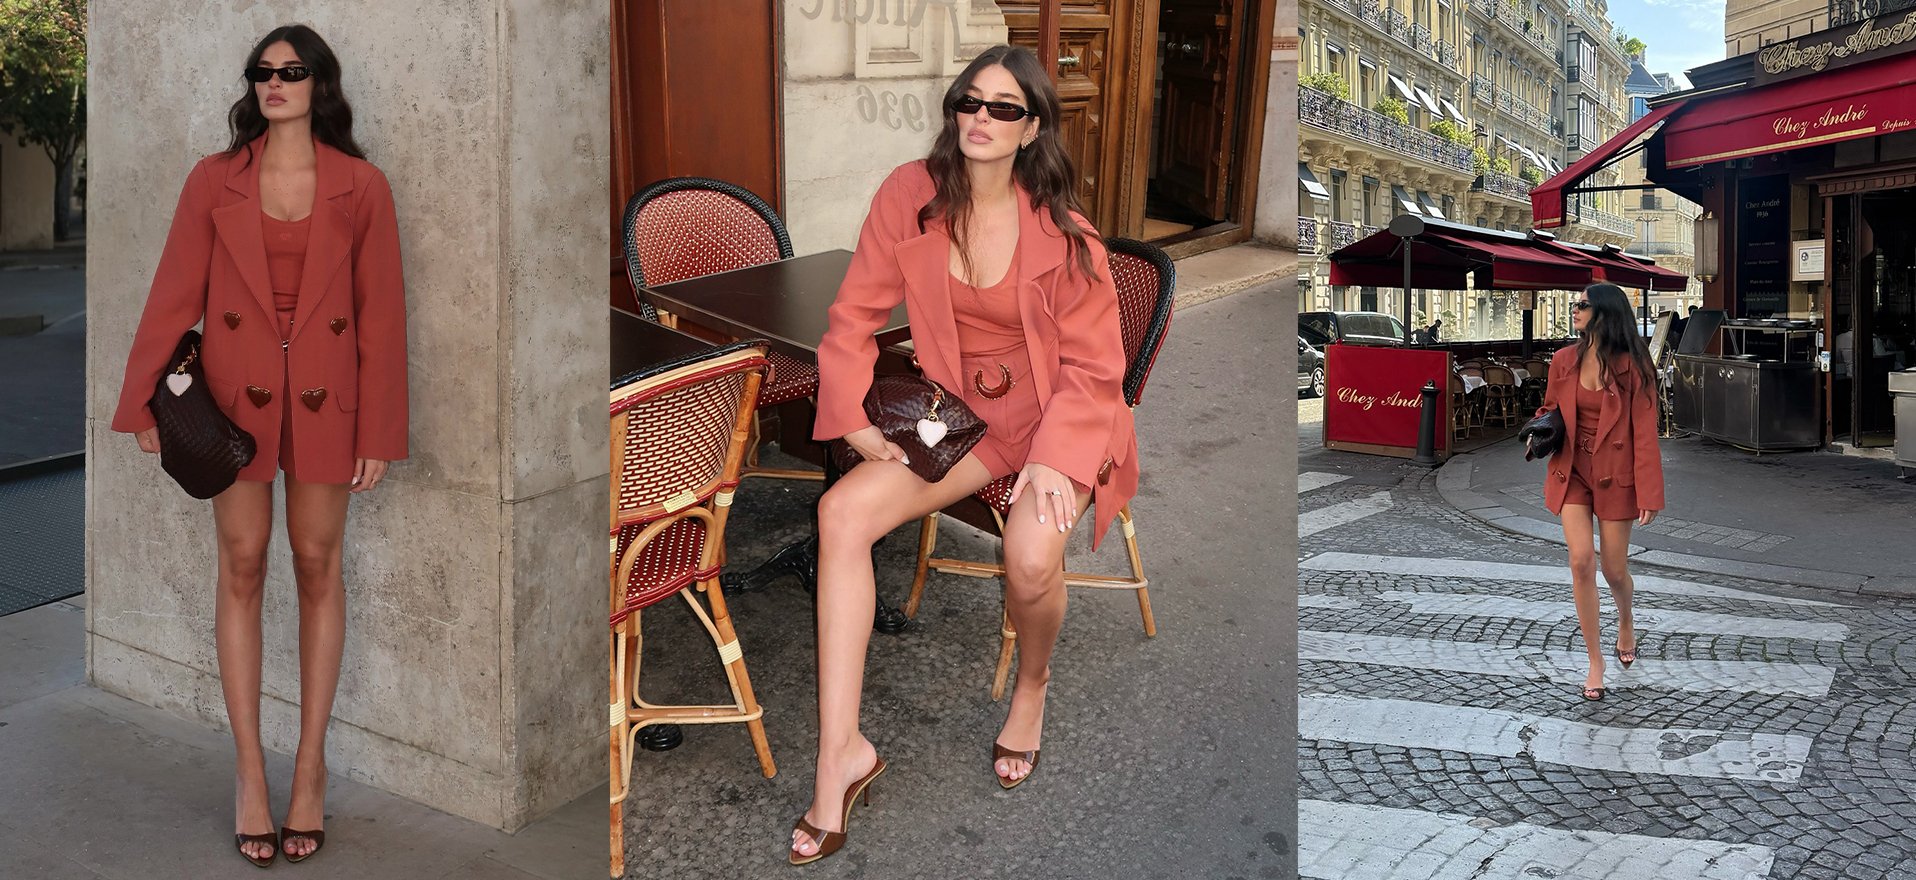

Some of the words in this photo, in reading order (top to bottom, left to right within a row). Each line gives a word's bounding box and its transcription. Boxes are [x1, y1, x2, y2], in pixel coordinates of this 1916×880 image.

[1759, 41, 1833, 74] Chez
[1834, 11, 1916, 57] And
[1773, 117, 1810, 138] Chez
[1813, 104, 1869, 129] André
[1882, 119, 1911, 132] Depuis
[1337, 387, 1377, 411] Chez
[1381, 391, 1423, 408] And
